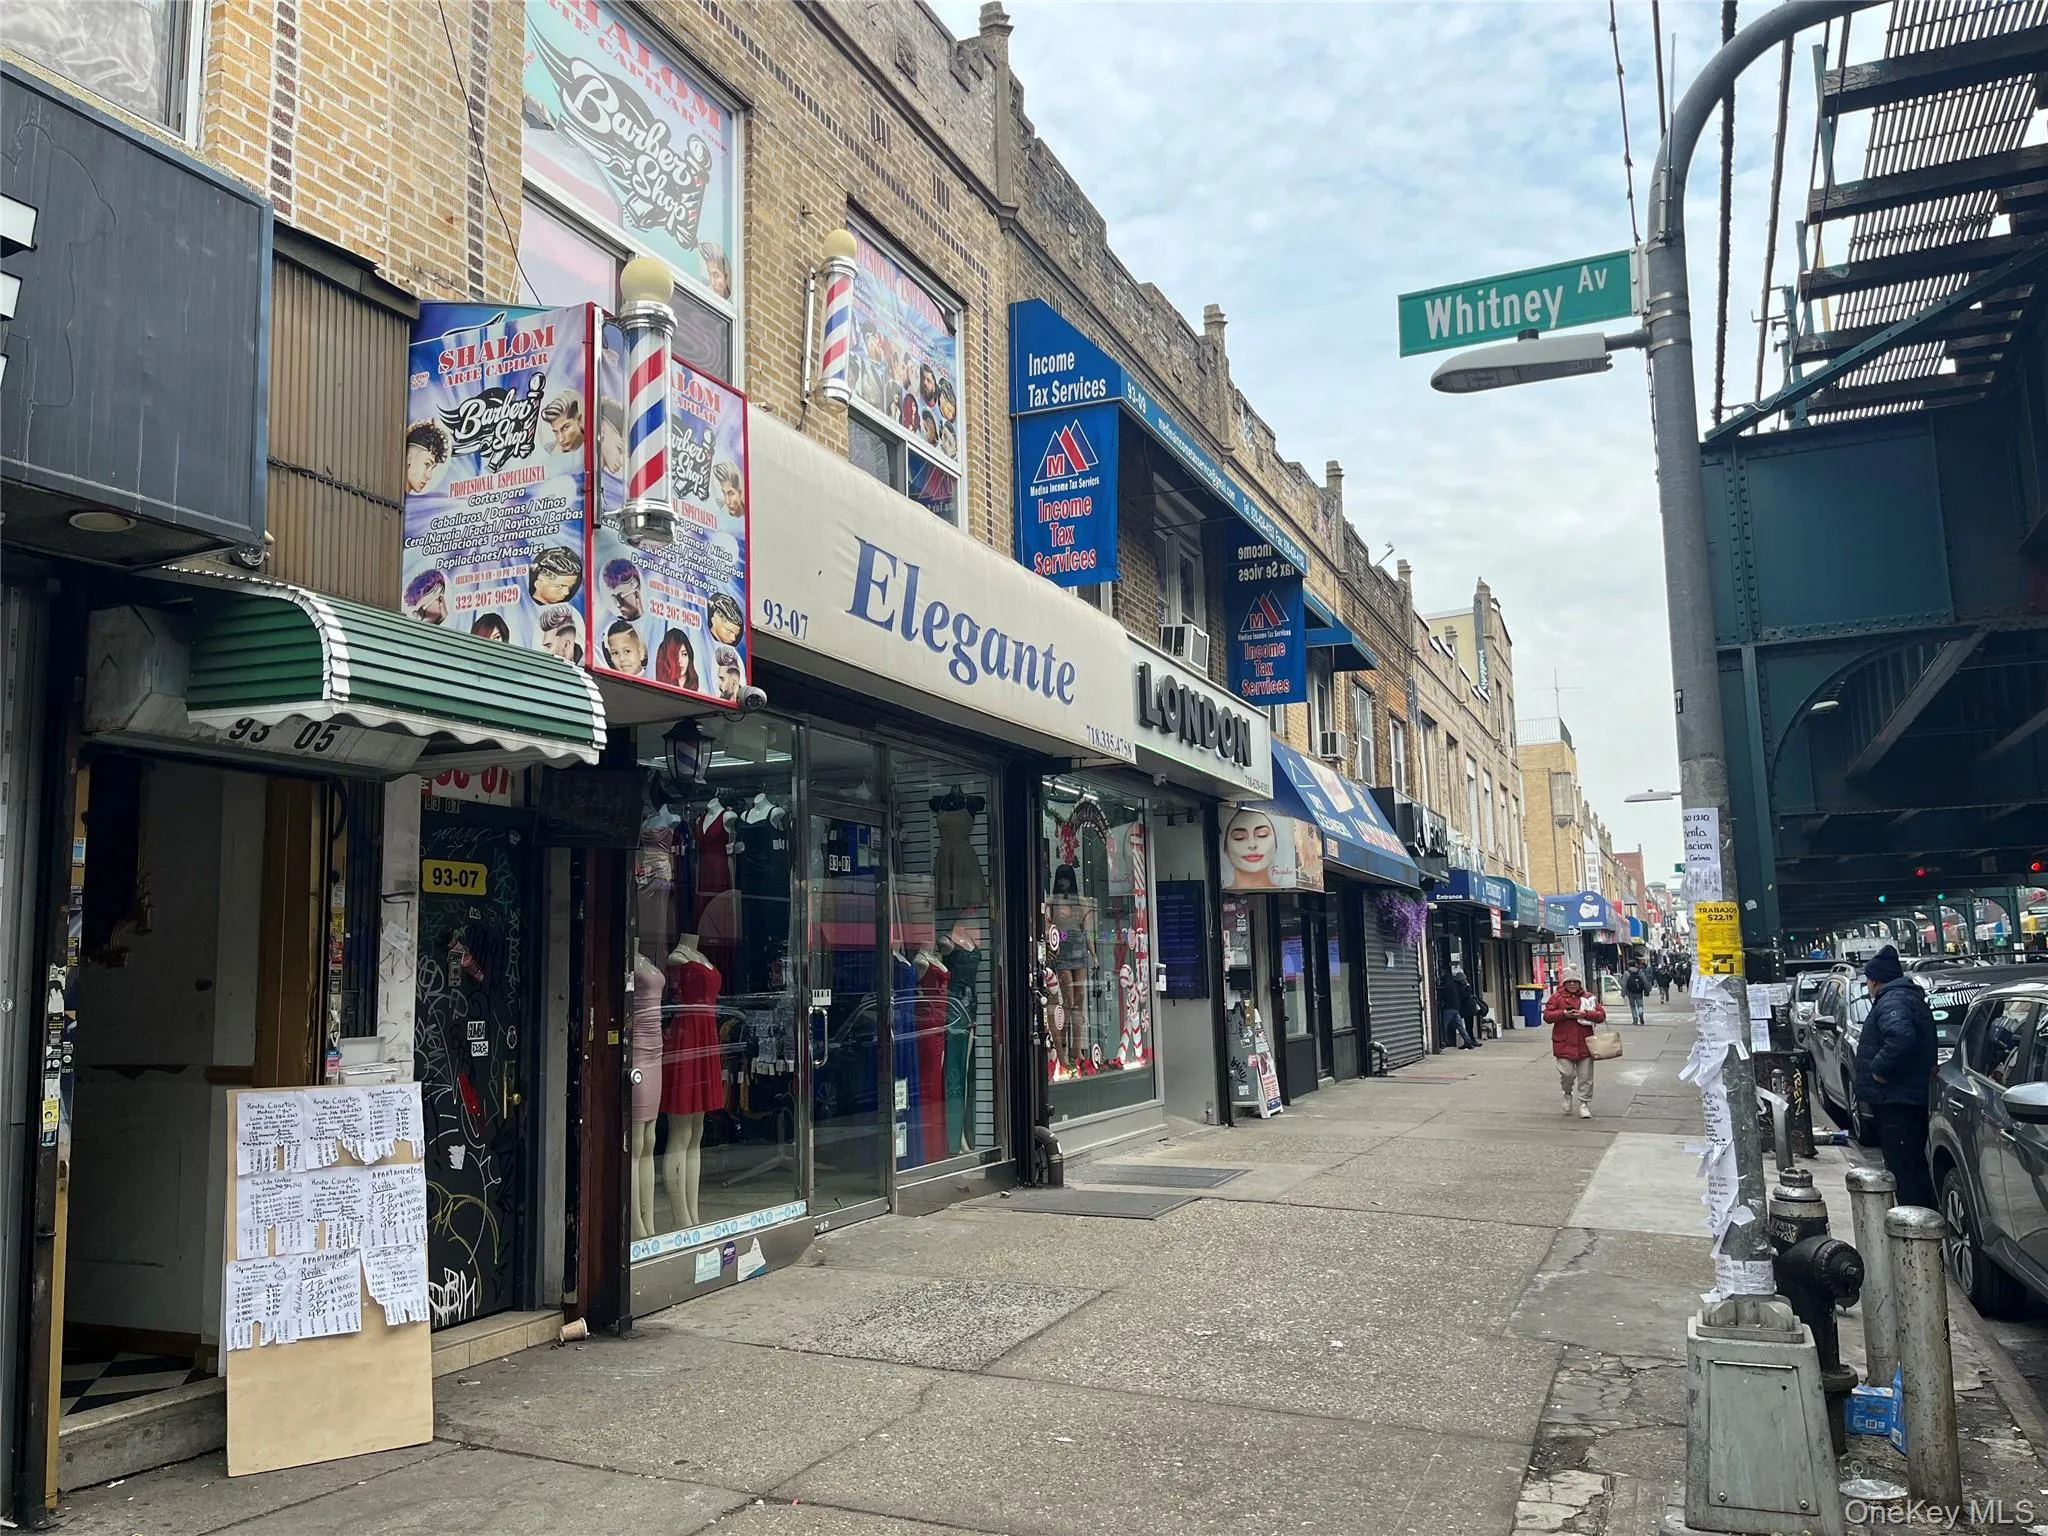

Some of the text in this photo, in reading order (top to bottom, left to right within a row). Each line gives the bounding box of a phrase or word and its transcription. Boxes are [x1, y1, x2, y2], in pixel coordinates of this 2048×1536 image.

[562, 58, 695, 188] Barber
[632, 152, 688, 237] Shop
[1424, 265, 1607, 340] Whitney Av
[438, 324, 555, 373] SHALOM
[444, 352, 549, 388] ARTE CAPILAR
[1029, 351, 1075, 377] Income
[1028, 376, 1106, 408] Tax Services
[454, 388, 530, 440] Barber
[493, 419, 528, 456] Shop
[677, 452, 705, 491] Shop
[1047, 453, 1065, 477] M
[450, 465, 545, 498] PROFESIONAL ESPECIALISTA
[1030, 475, 1100, 497] Medina Income Tax Services
[469, 487, 525, 506] Cortes para
[1038, 496, 1092, 523] Income
[431, 513, 482, 530] Caballeros
[490, 504, 525, 519] Damas
[469, 521, 497, 536] Facial
[505, 514, 540, 533] Rayitos
[549, 508, 583, 523] Barbas
[422, 523, 559, 556] Ondulaciones permanentes
[677, 531, 705, 550] Damas
[1050, 522, 1075, 547] Tax
[436, 543, 544, 570] Depilaciones/Masajes
[1033, 547, 1096, 576] Services
[631, 552, 719, 593] Depilaciones/Masajes
[679, 558, 729, 583] permanentes
[721, 562, 744, 579] Barbas
[475, 592, 492, 607] 207
[763, 598, 809, 640] 93-07
[845, 536, 1076, 705] Elegante
[1249, 613, 1263, 629] M
[1253, 631, 1267, 640] Income
[1274, 629, 1291, 638] Services
[1244, 642, 1286, 660] Income
[1254, 660, 1274, 677] Tax
[1241, 677, 1290, 697] Services
[1135, 661, 1252, 768] LONDON
[294, 721, 342, 752] 05
[432, 867, 479, 888] 93-07
[1698, 906, 1738, 914] TRABAJOS
